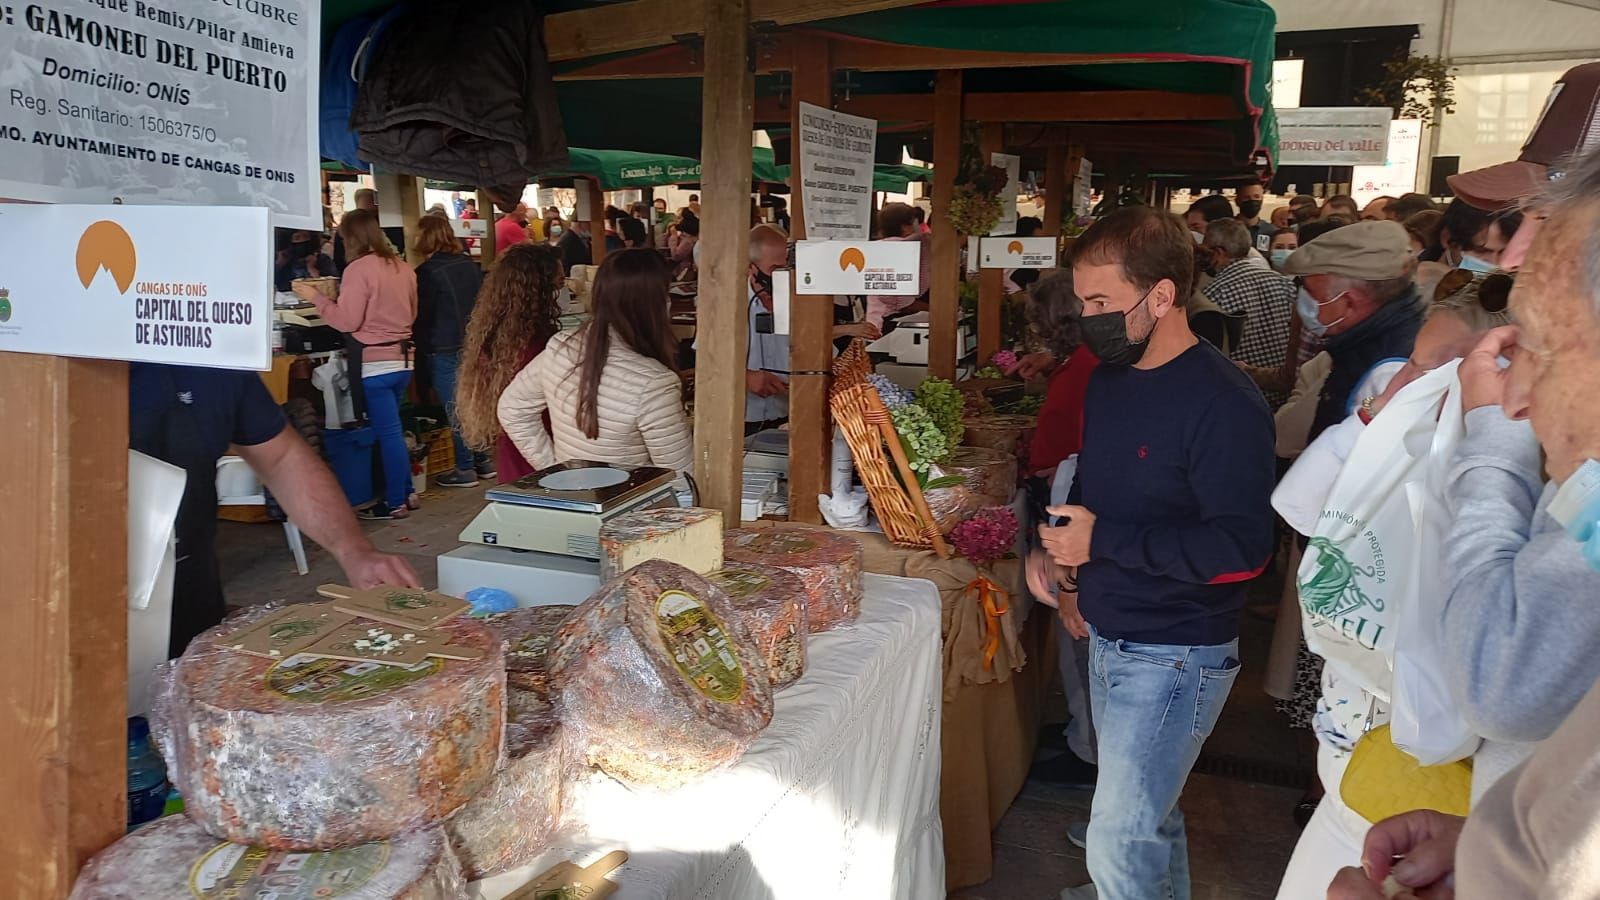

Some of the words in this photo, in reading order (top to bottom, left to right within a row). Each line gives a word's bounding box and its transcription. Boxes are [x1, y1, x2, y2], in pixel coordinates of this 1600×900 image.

[25, 4, 147, 58] GAMONEU
[155, 38, 198, 72] DEL
[205, 51, 287, 93] PUERTO
[135, 0, 235, 43] Remis/Pilar
[241, 32, 295, 59] Amieva
[42, 57, 140, 95] Domicilio:
[147, 82, 191, 106] ONÍS
[10, 88, 52, 116] Reg.
[57, 98, 134, 128] Sanitario:
[32, 131, 156, 162] AYUNTAMIENTO
[161, 151, 180, 167] DE
[185, 156, 241, 176] CANGAS
[245, 166, 262, 179] DE
[265, 169, 295, 184] ONIS
[136, 282, 170, 295] CANGAS
[172, 284, 184, 296] DE
[186, 282, 208, 297] ONÍS
[136, 297, 184, 322] CAPITAL
[187, 300, 209, 323] DEL
[212, 301, 252, 325] QUESO
[136, 322, 150, 345] DE
[153, 323, 212, 348] ASTURIAS
[1363, 530, 1386, 584] PROTEGIDA
